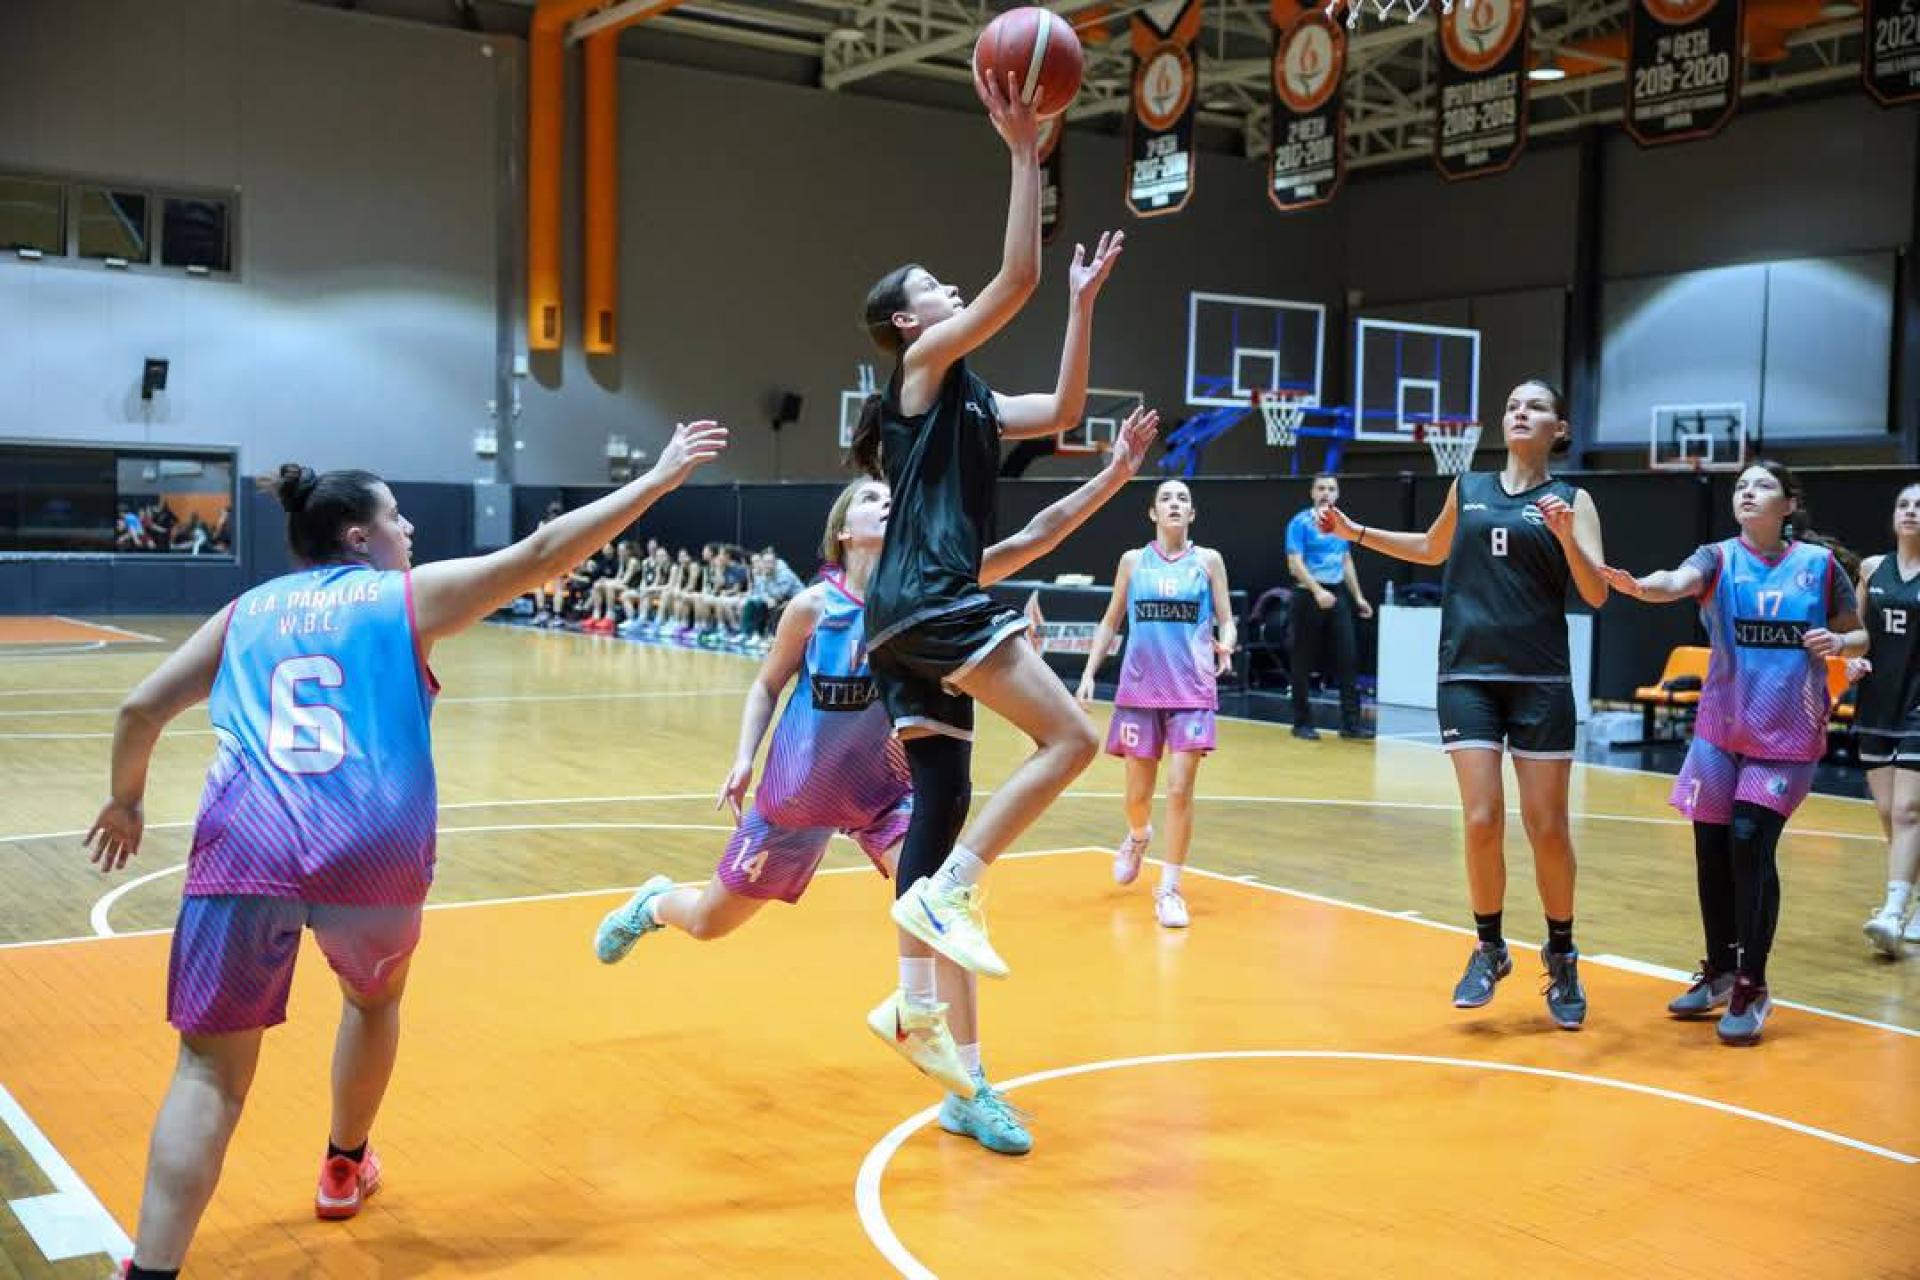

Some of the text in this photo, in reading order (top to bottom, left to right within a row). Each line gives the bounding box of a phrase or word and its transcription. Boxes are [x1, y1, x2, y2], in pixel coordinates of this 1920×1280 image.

[1491, 527, 1508, 556] 8
[287, 582, 380, 609] PARALIAS
[1157, 578, 1178, 598] 16
[1756, 591, 1784, 617] 17
[1882, 608, 1907, 634] 12
[268, 655, 347, 775] 6
[1119, 721, 1140, 747] 16
[731, 837, 769, 883] 14
